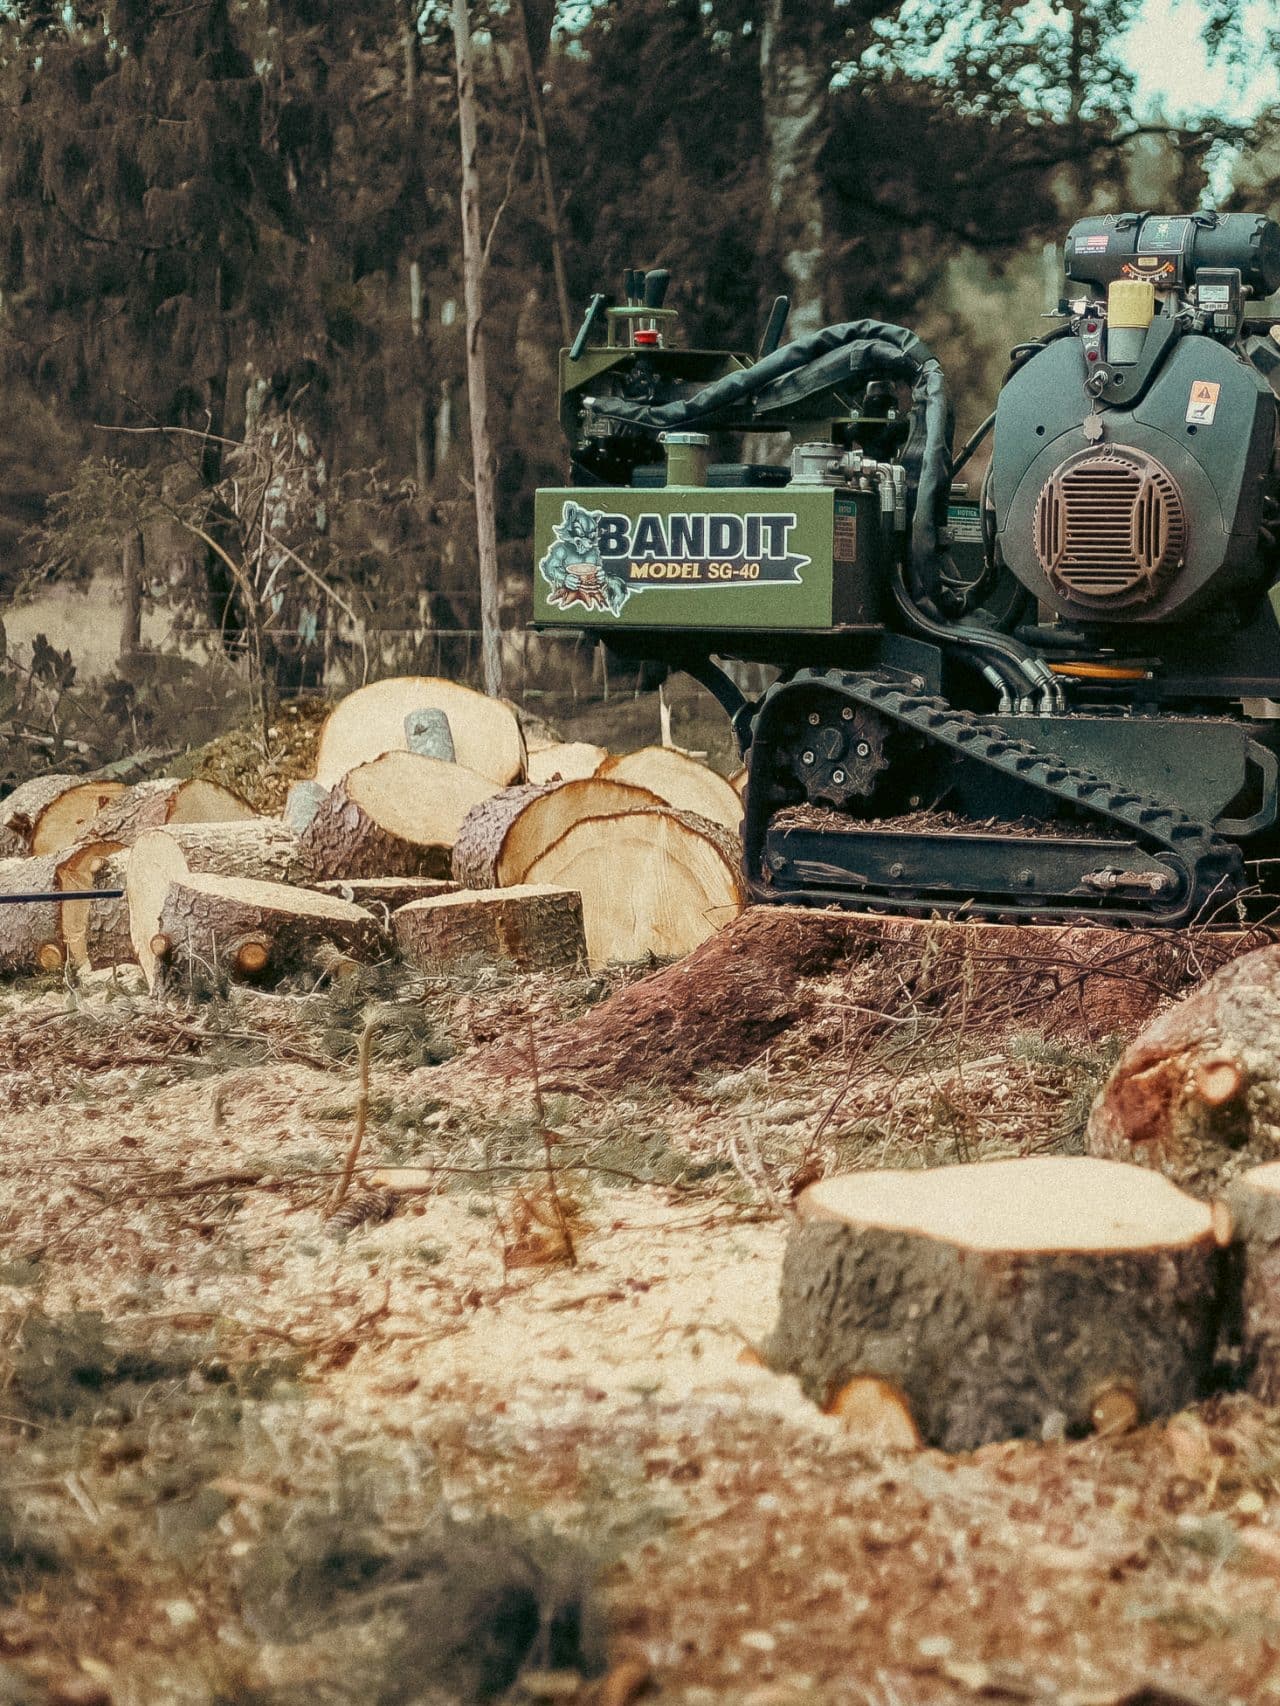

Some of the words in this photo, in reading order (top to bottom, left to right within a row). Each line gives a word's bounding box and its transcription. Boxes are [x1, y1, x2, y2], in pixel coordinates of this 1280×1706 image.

[600, 515, 795, 558] BANDIT
[630, 562, 702, 579] MODEL
[708, 562, 760, 579] SG-40
